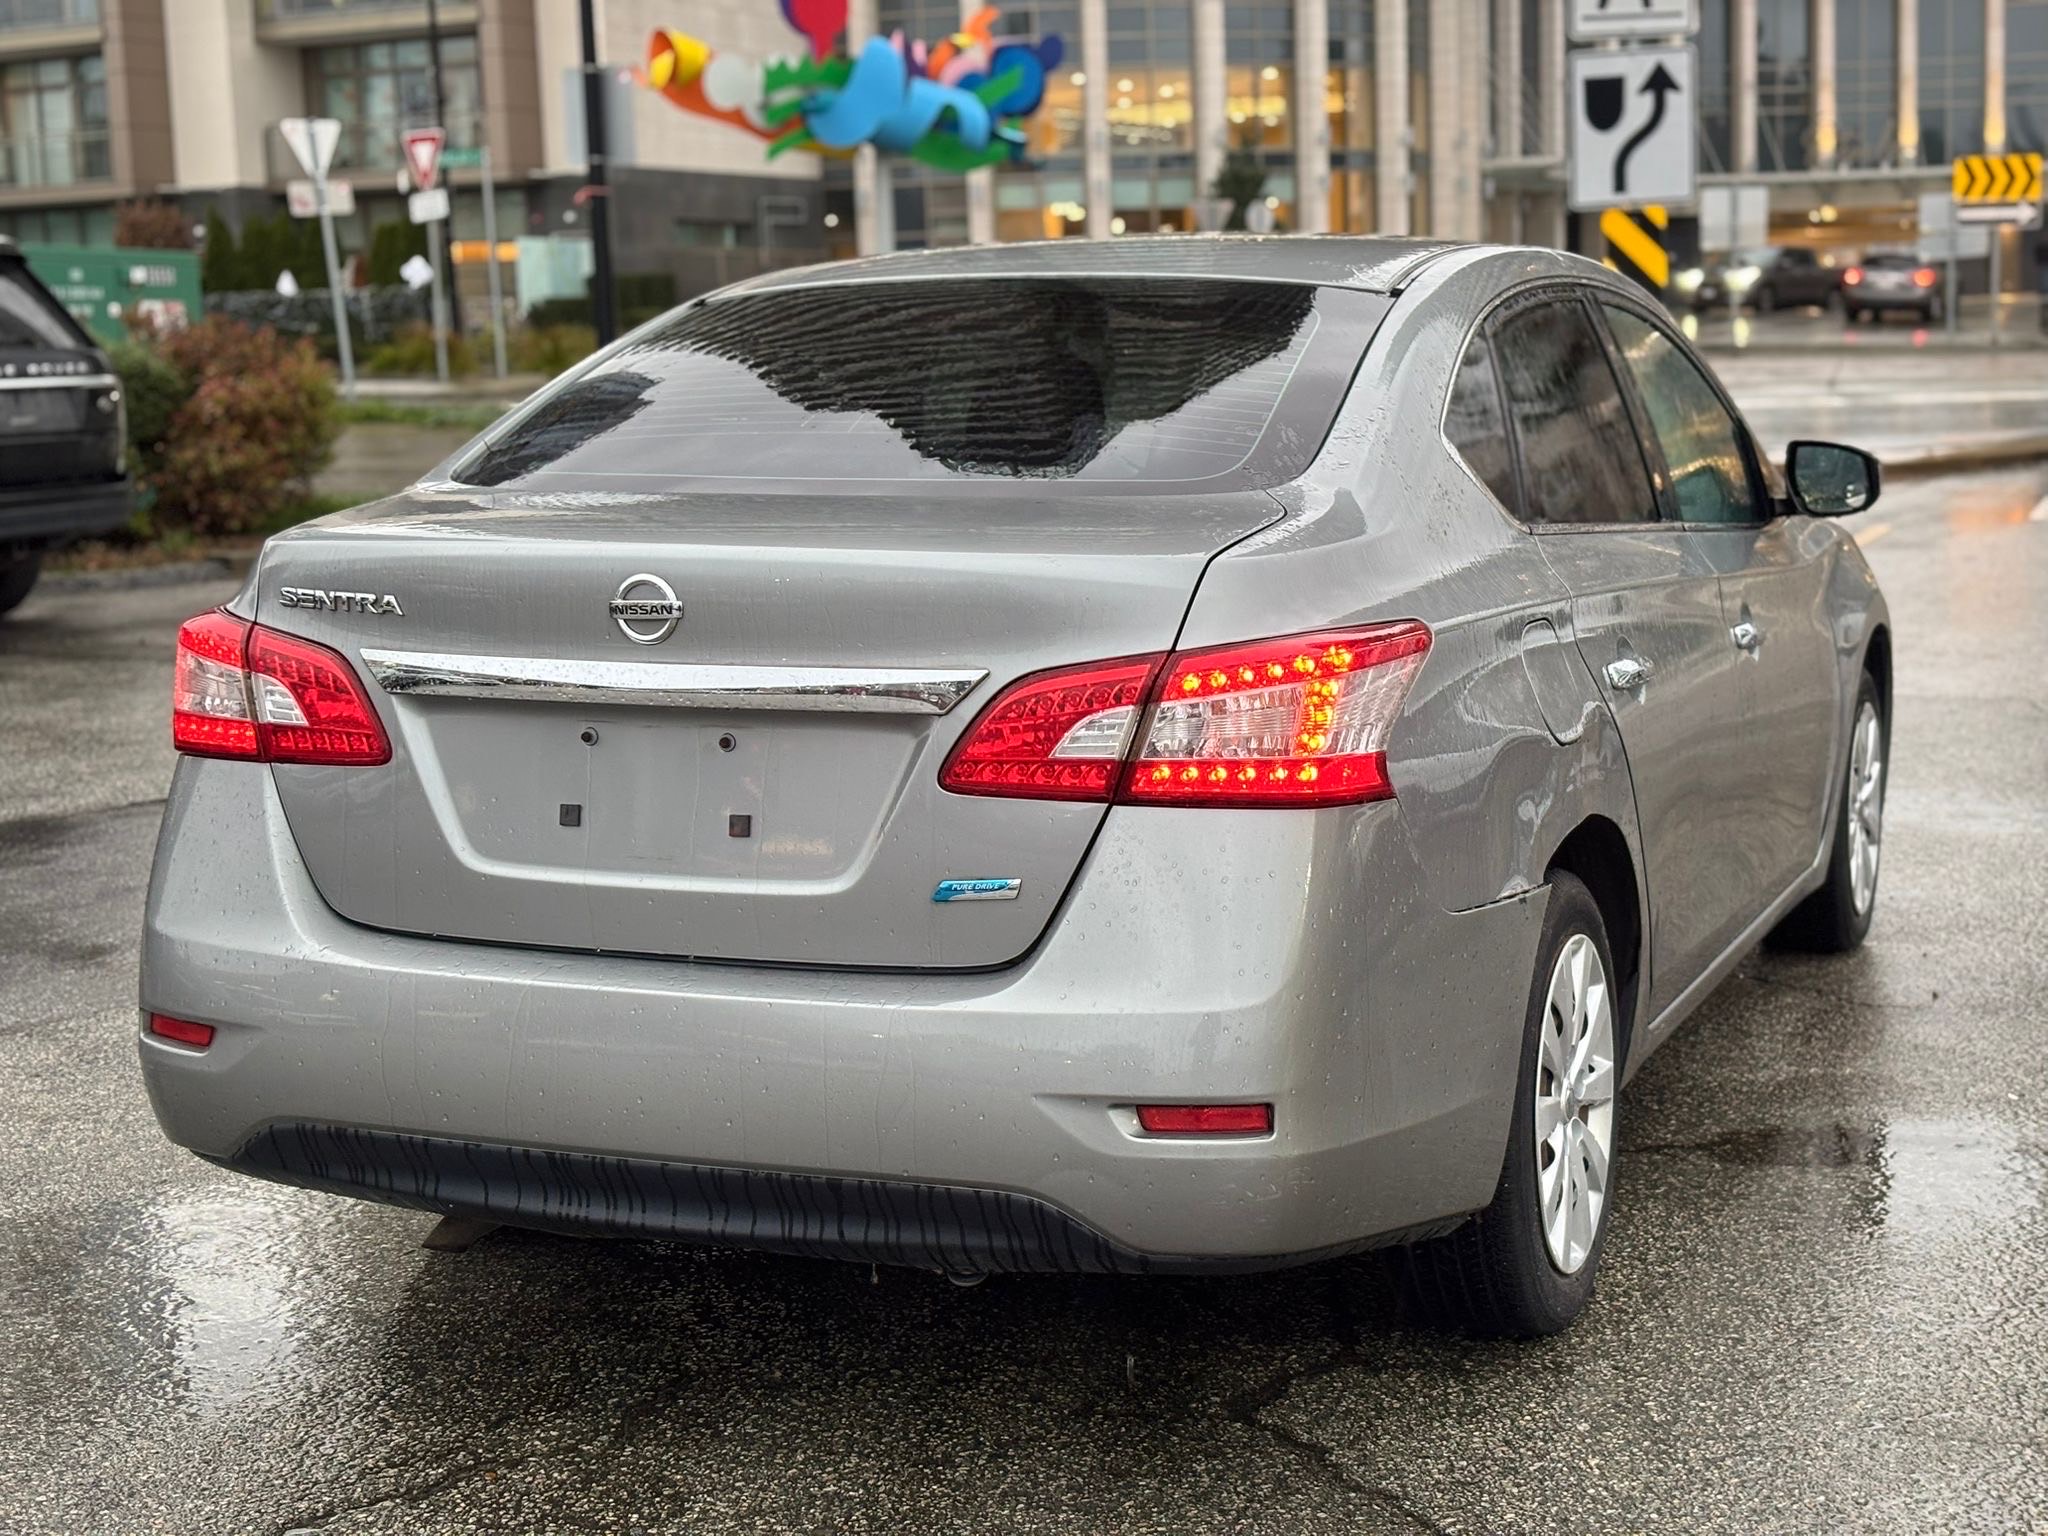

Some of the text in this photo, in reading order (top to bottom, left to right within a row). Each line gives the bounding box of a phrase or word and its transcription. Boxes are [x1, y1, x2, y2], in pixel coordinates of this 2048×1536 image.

[279, 586, 405, 616] SENTRA
[614, 604, 673, 615] NISSAN
[951, 883, 974, 891] PURE
